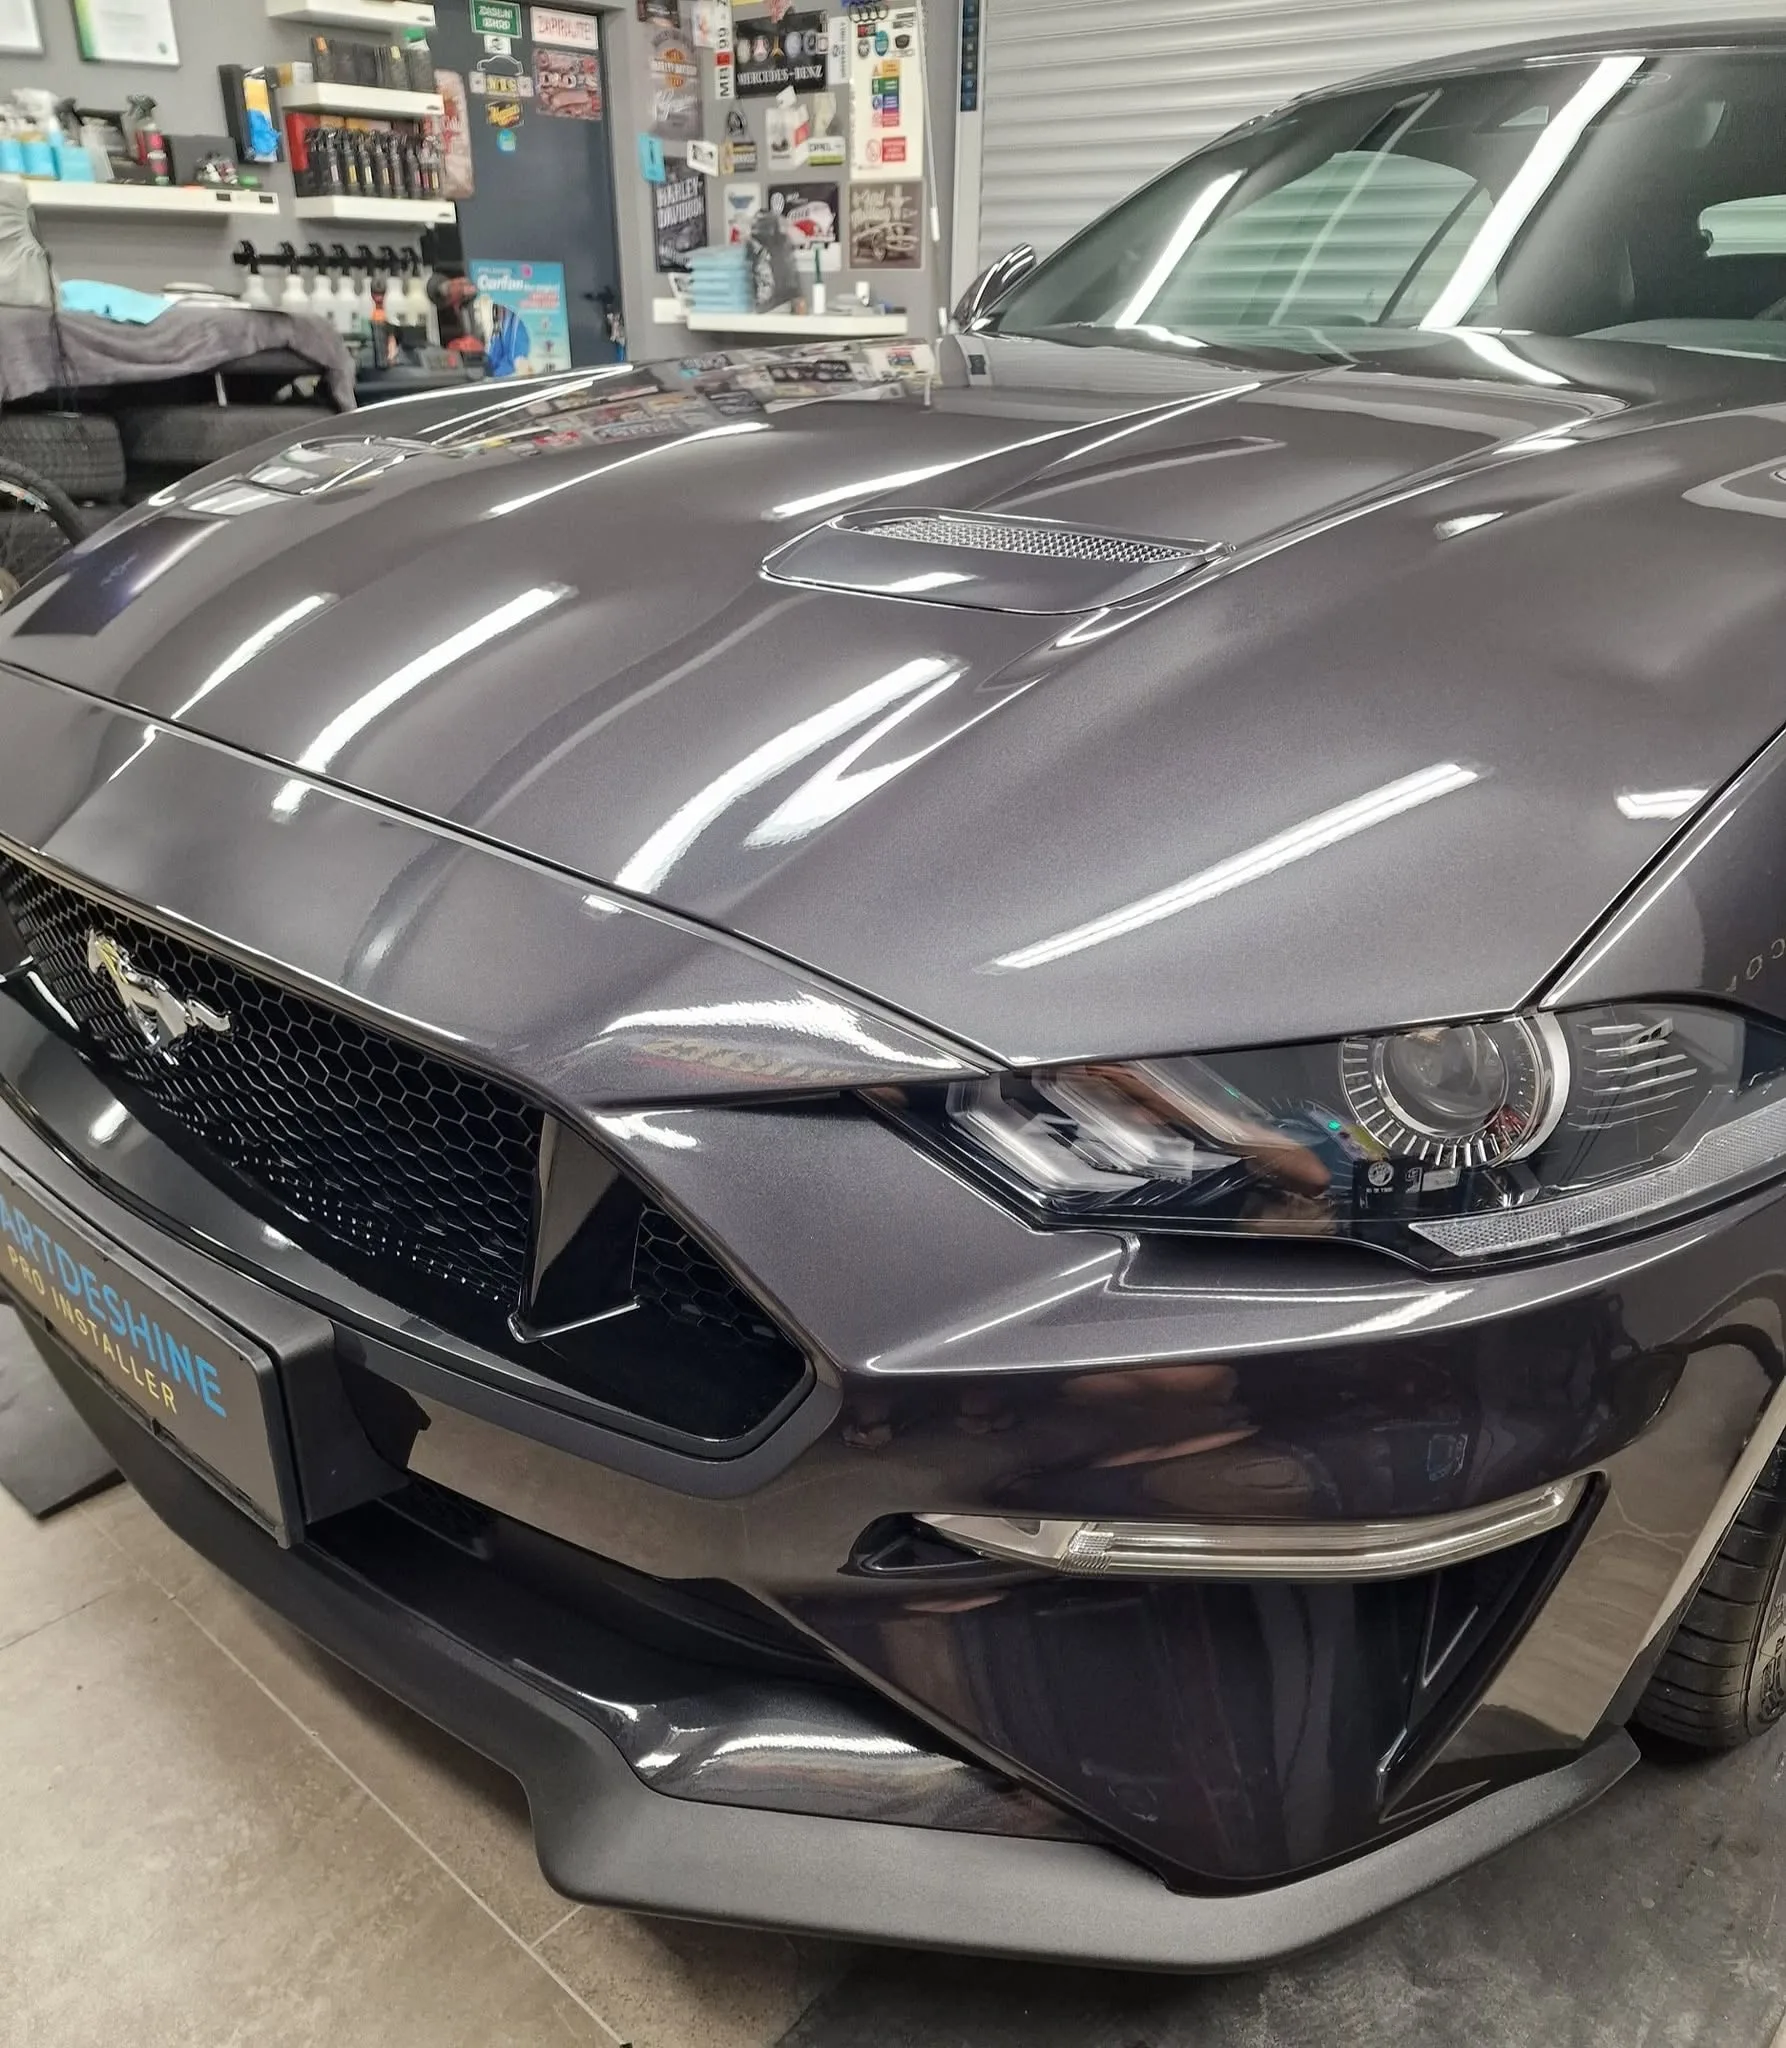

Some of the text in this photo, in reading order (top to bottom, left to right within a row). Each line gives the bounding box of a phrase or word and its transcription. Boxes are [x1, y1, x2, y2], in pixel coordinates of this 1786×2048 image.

[0, 1193, 227, 1418] ARTDESHINE
[7, 1244, 177, 1415] PRO INSTALLER
